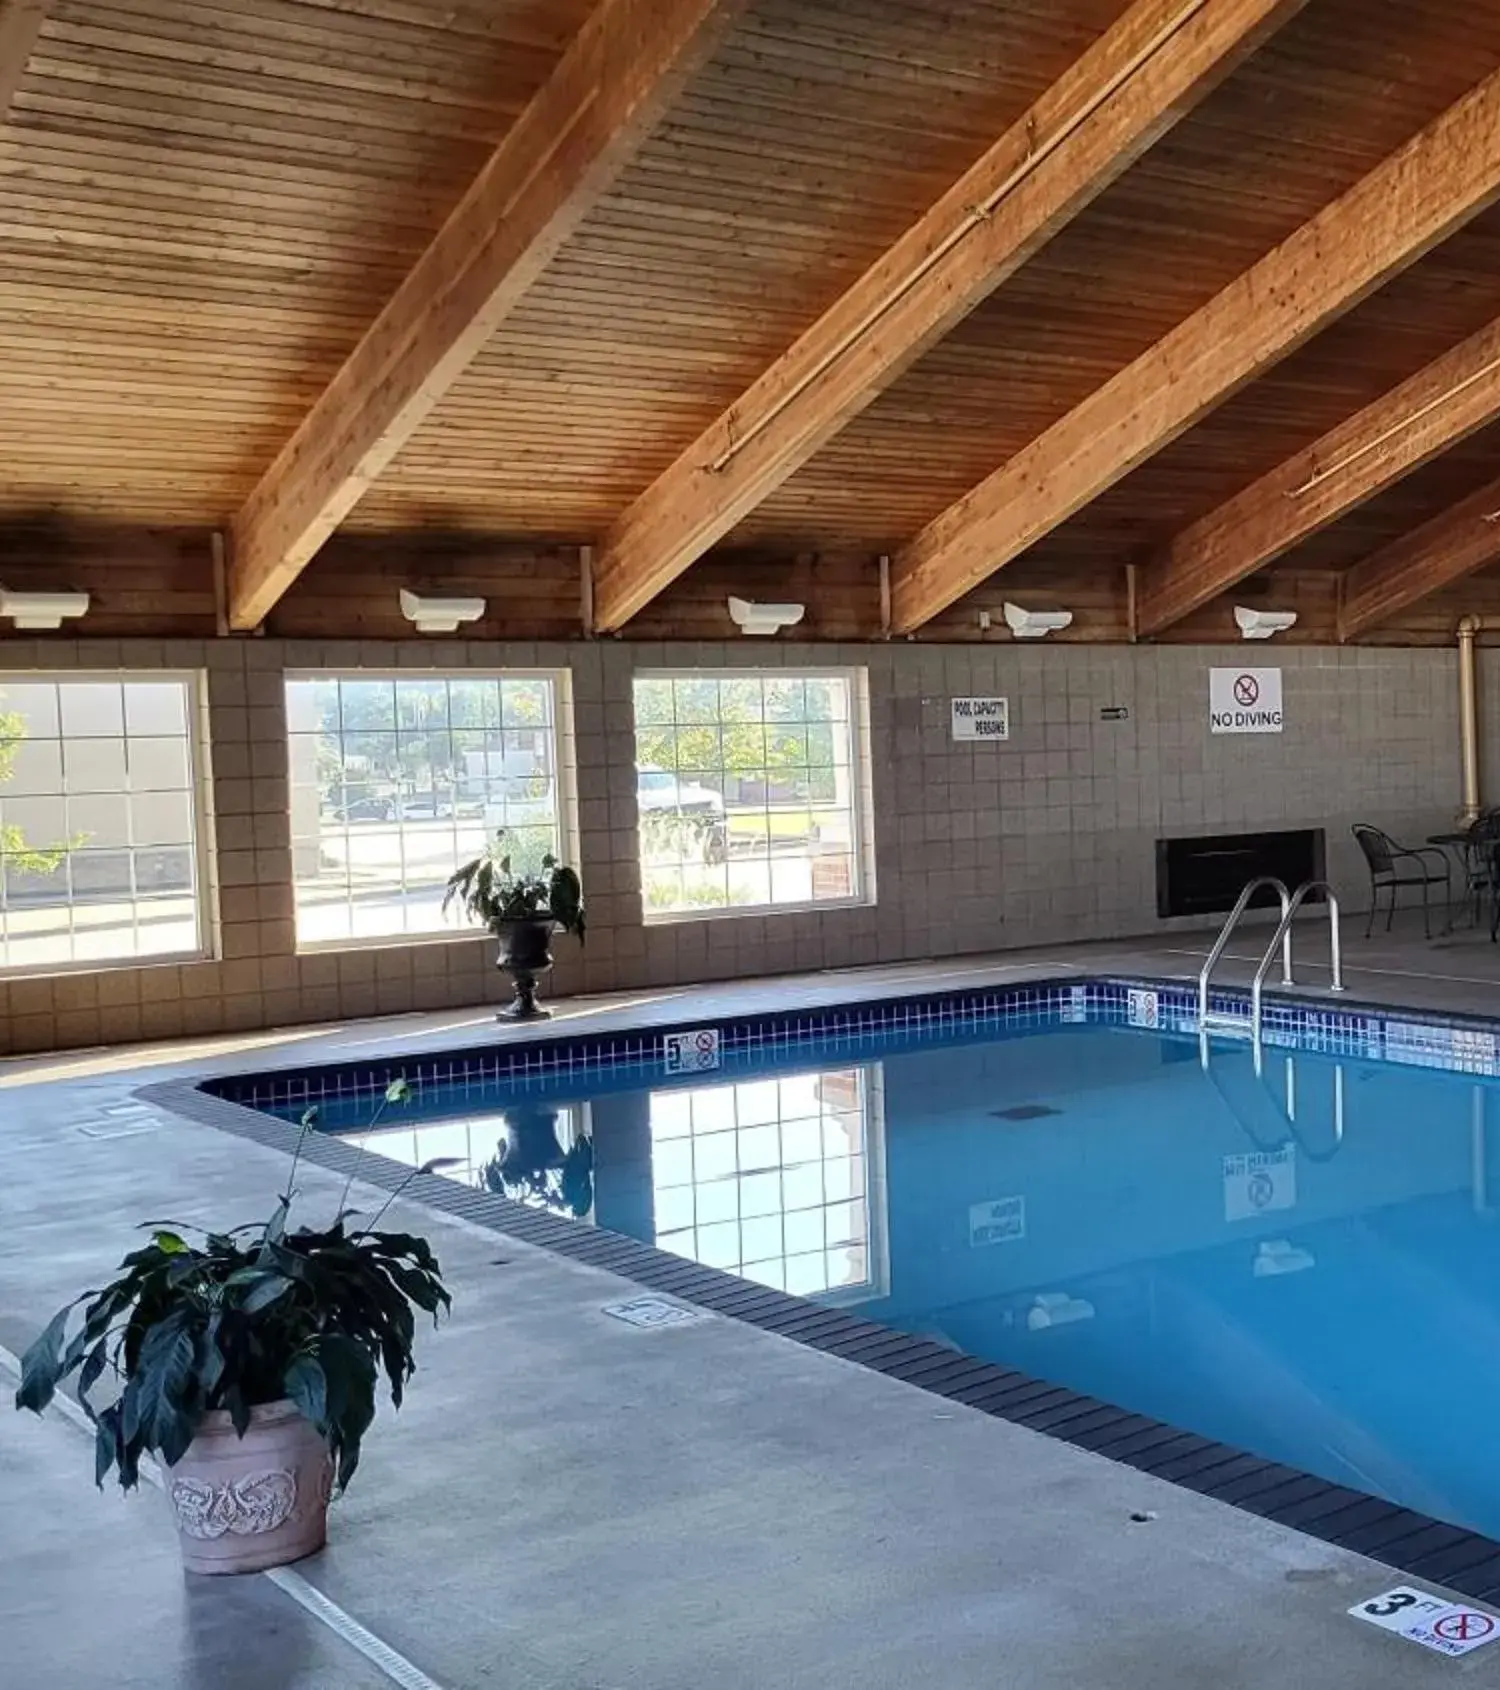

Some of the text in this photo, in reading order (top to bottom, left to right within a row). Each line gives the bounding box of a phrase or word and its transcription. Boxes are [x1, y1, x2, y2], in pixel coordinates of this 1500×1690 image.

[955, 701, 972, 716] POOL
[1211, 711, 1281, 727] NO DIVING
[975, 720, 1005, 735] PERSONS
[1364, 1593, 1417, 1616] 3
